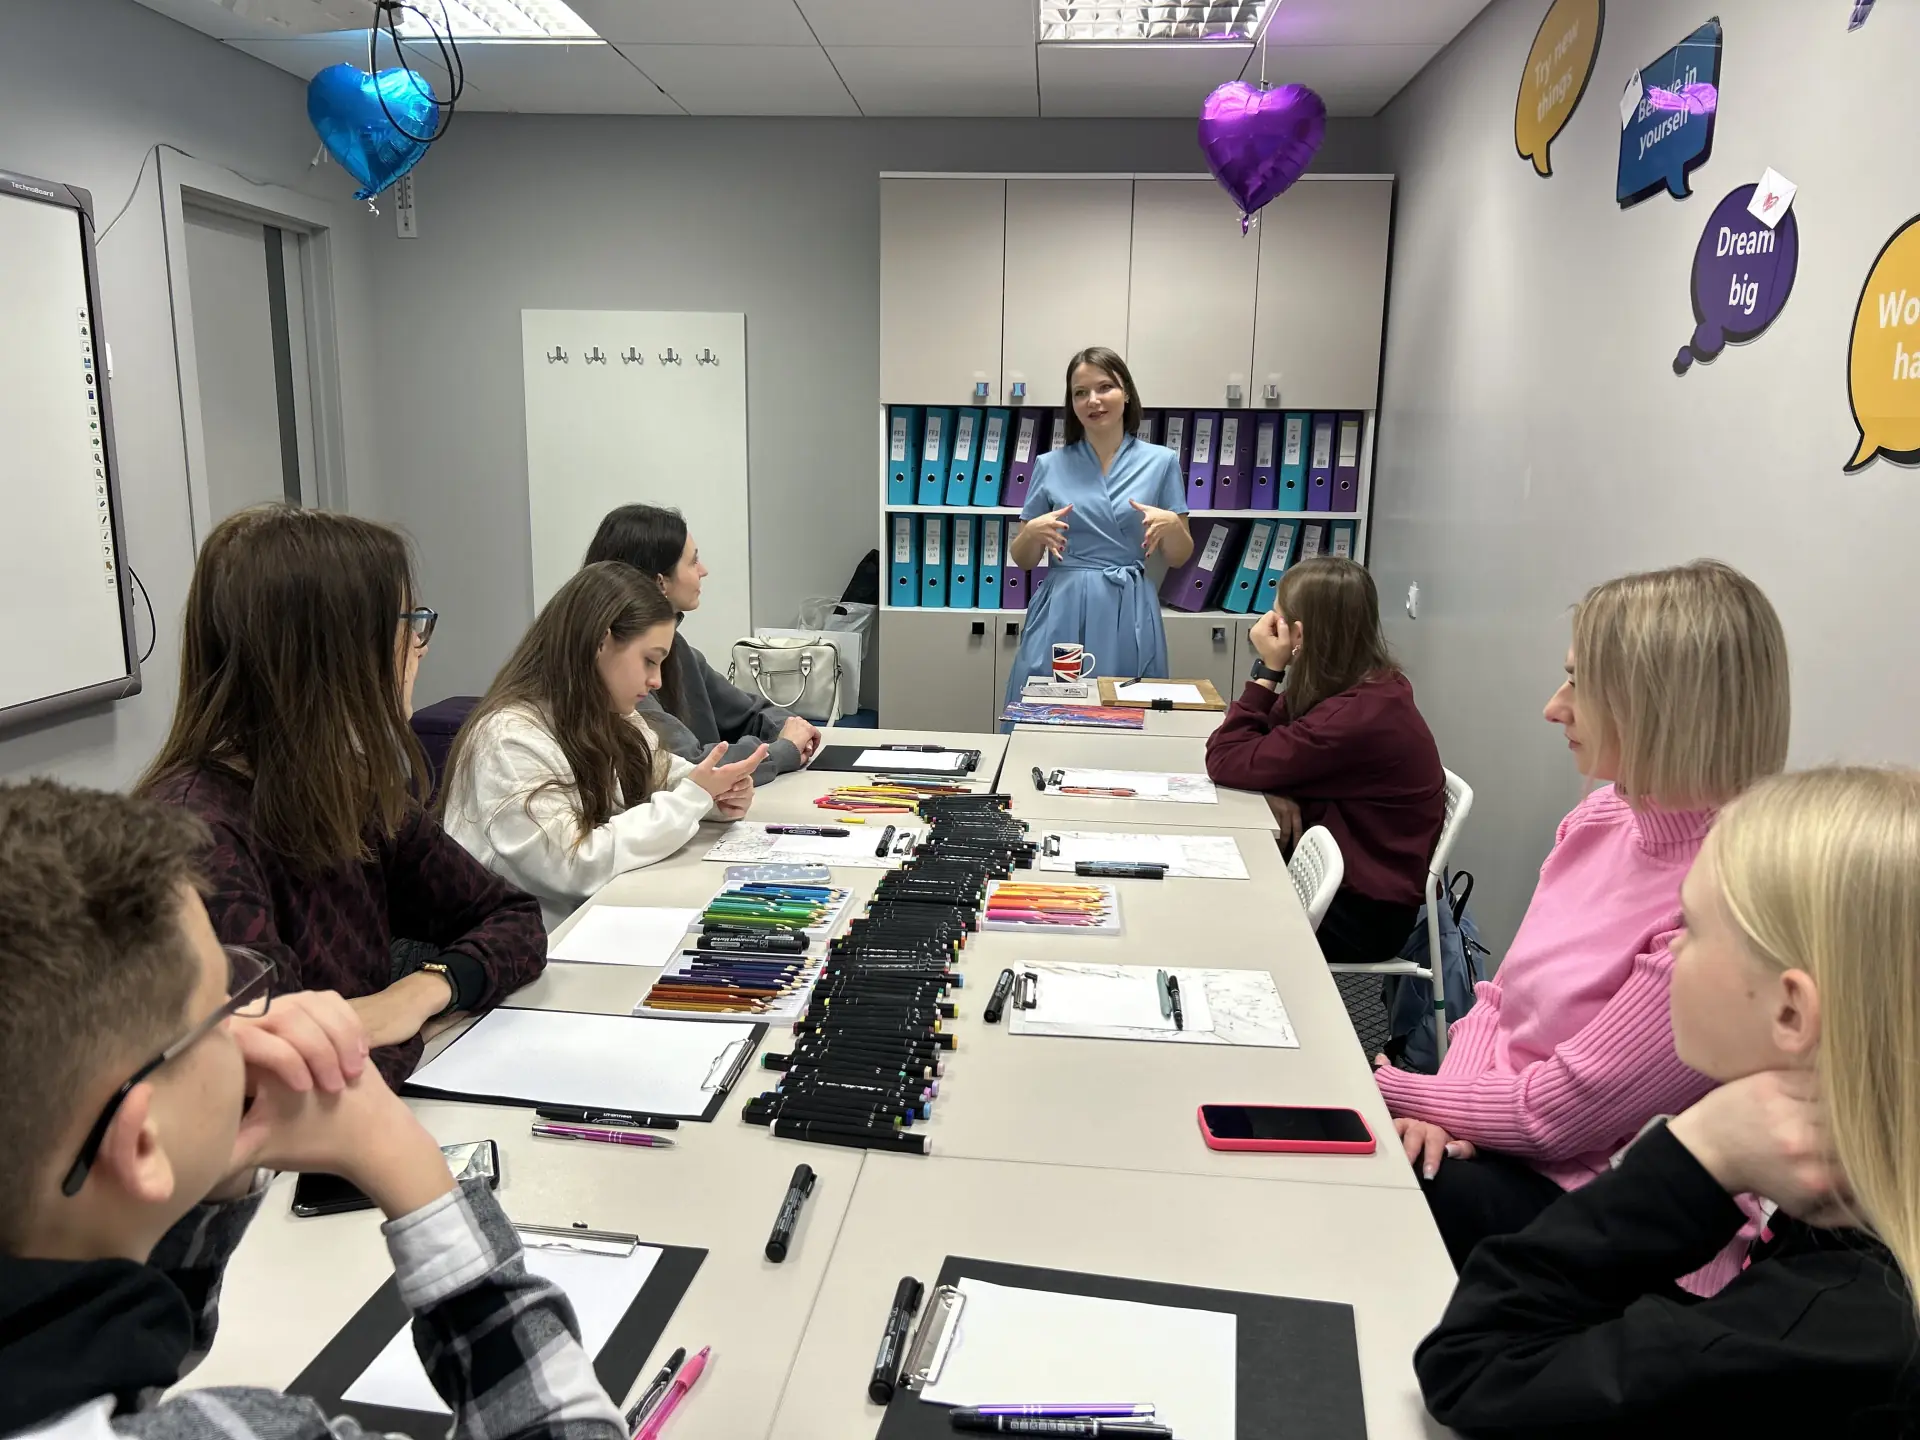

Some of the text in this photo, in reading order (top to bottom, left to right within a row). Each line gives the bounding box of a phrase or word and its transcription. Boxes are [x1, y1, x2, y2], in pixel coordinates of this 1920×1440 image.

[1535, 18, 1579, 91] Try new
[1537, 66, 1573, 124] things
[1685, 65, 1697, 92] in
[1638, 101, 1691, 161] yourself
[11, 181, 54, 197] TechnoBoard
[1716, 226, 1776, 257] Dream
[1728, 272, 1759, 315] big
